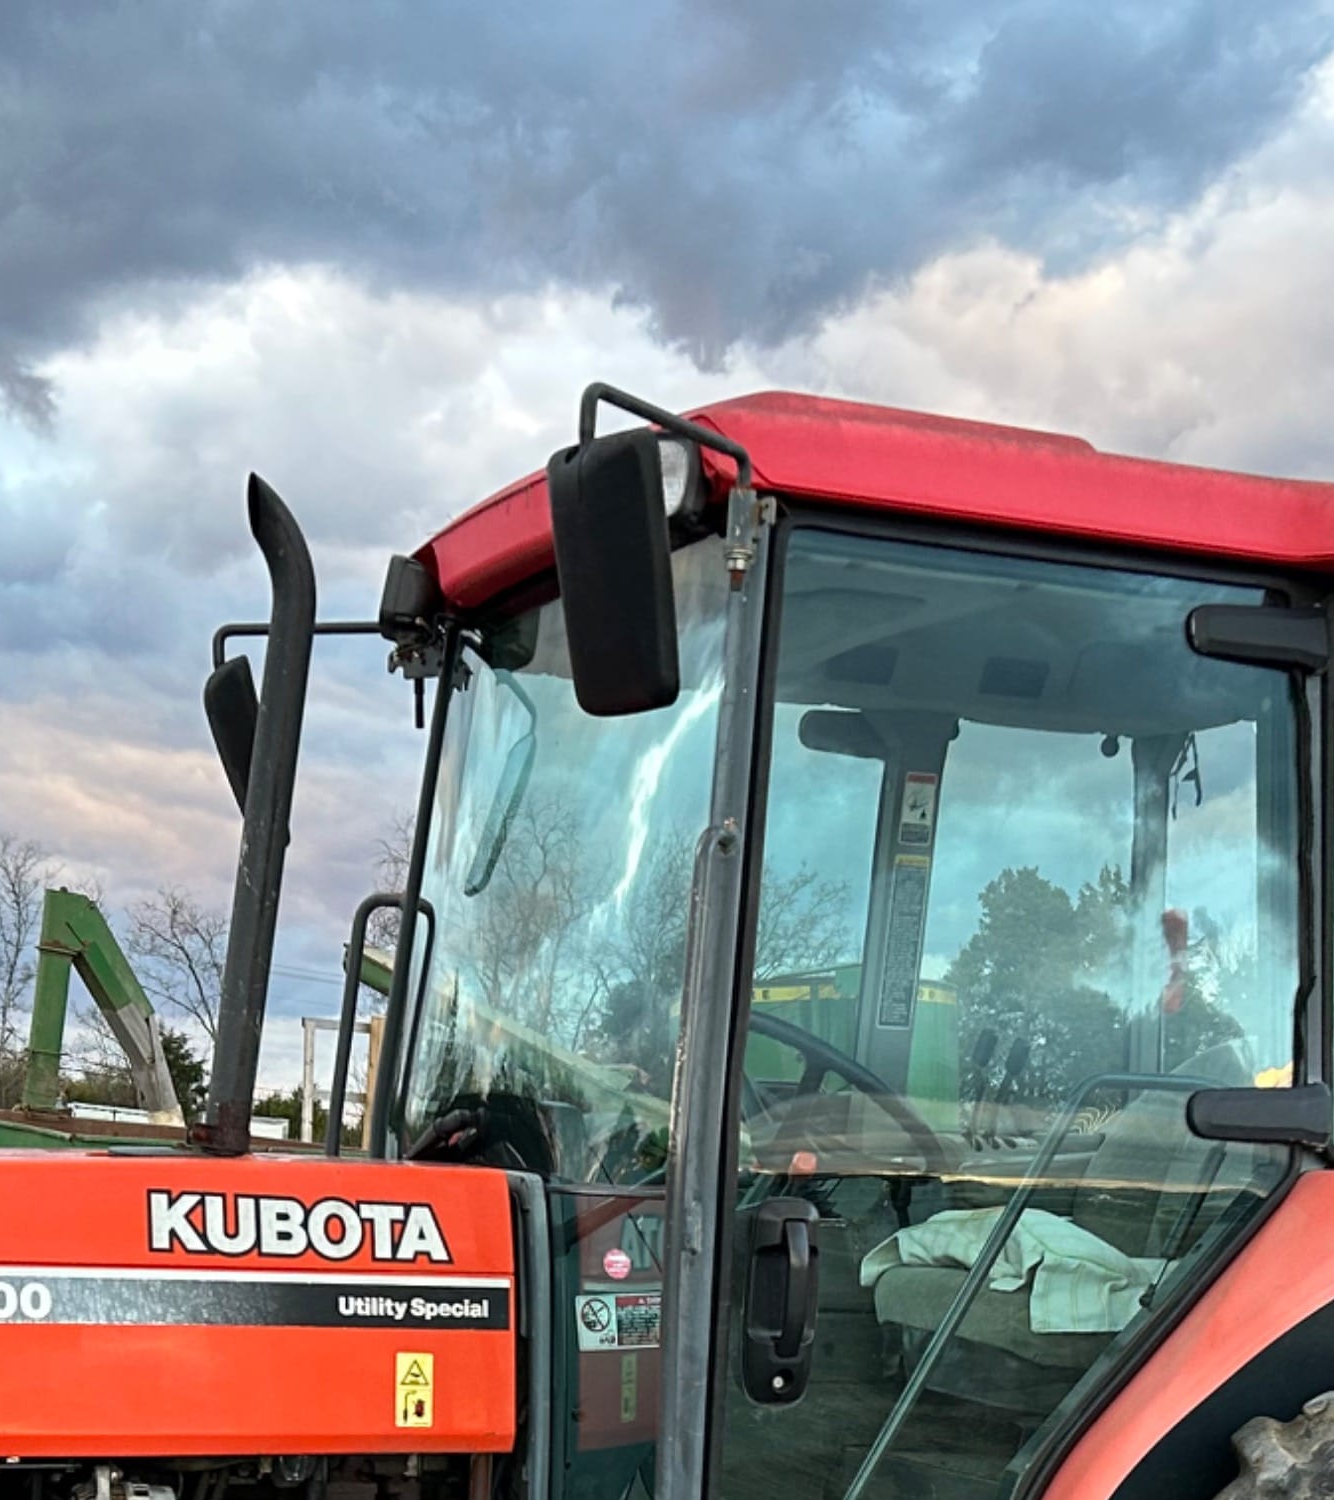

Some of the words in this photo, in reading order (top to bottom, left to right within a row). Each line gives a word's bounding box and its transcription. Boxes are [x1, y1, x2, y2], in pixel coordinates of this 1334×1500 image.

[148, 1190, 453, 1264] KUBOTA
[338, 1296, 408, 1320] Utility
[410, 1297, 489, 1320] Special
